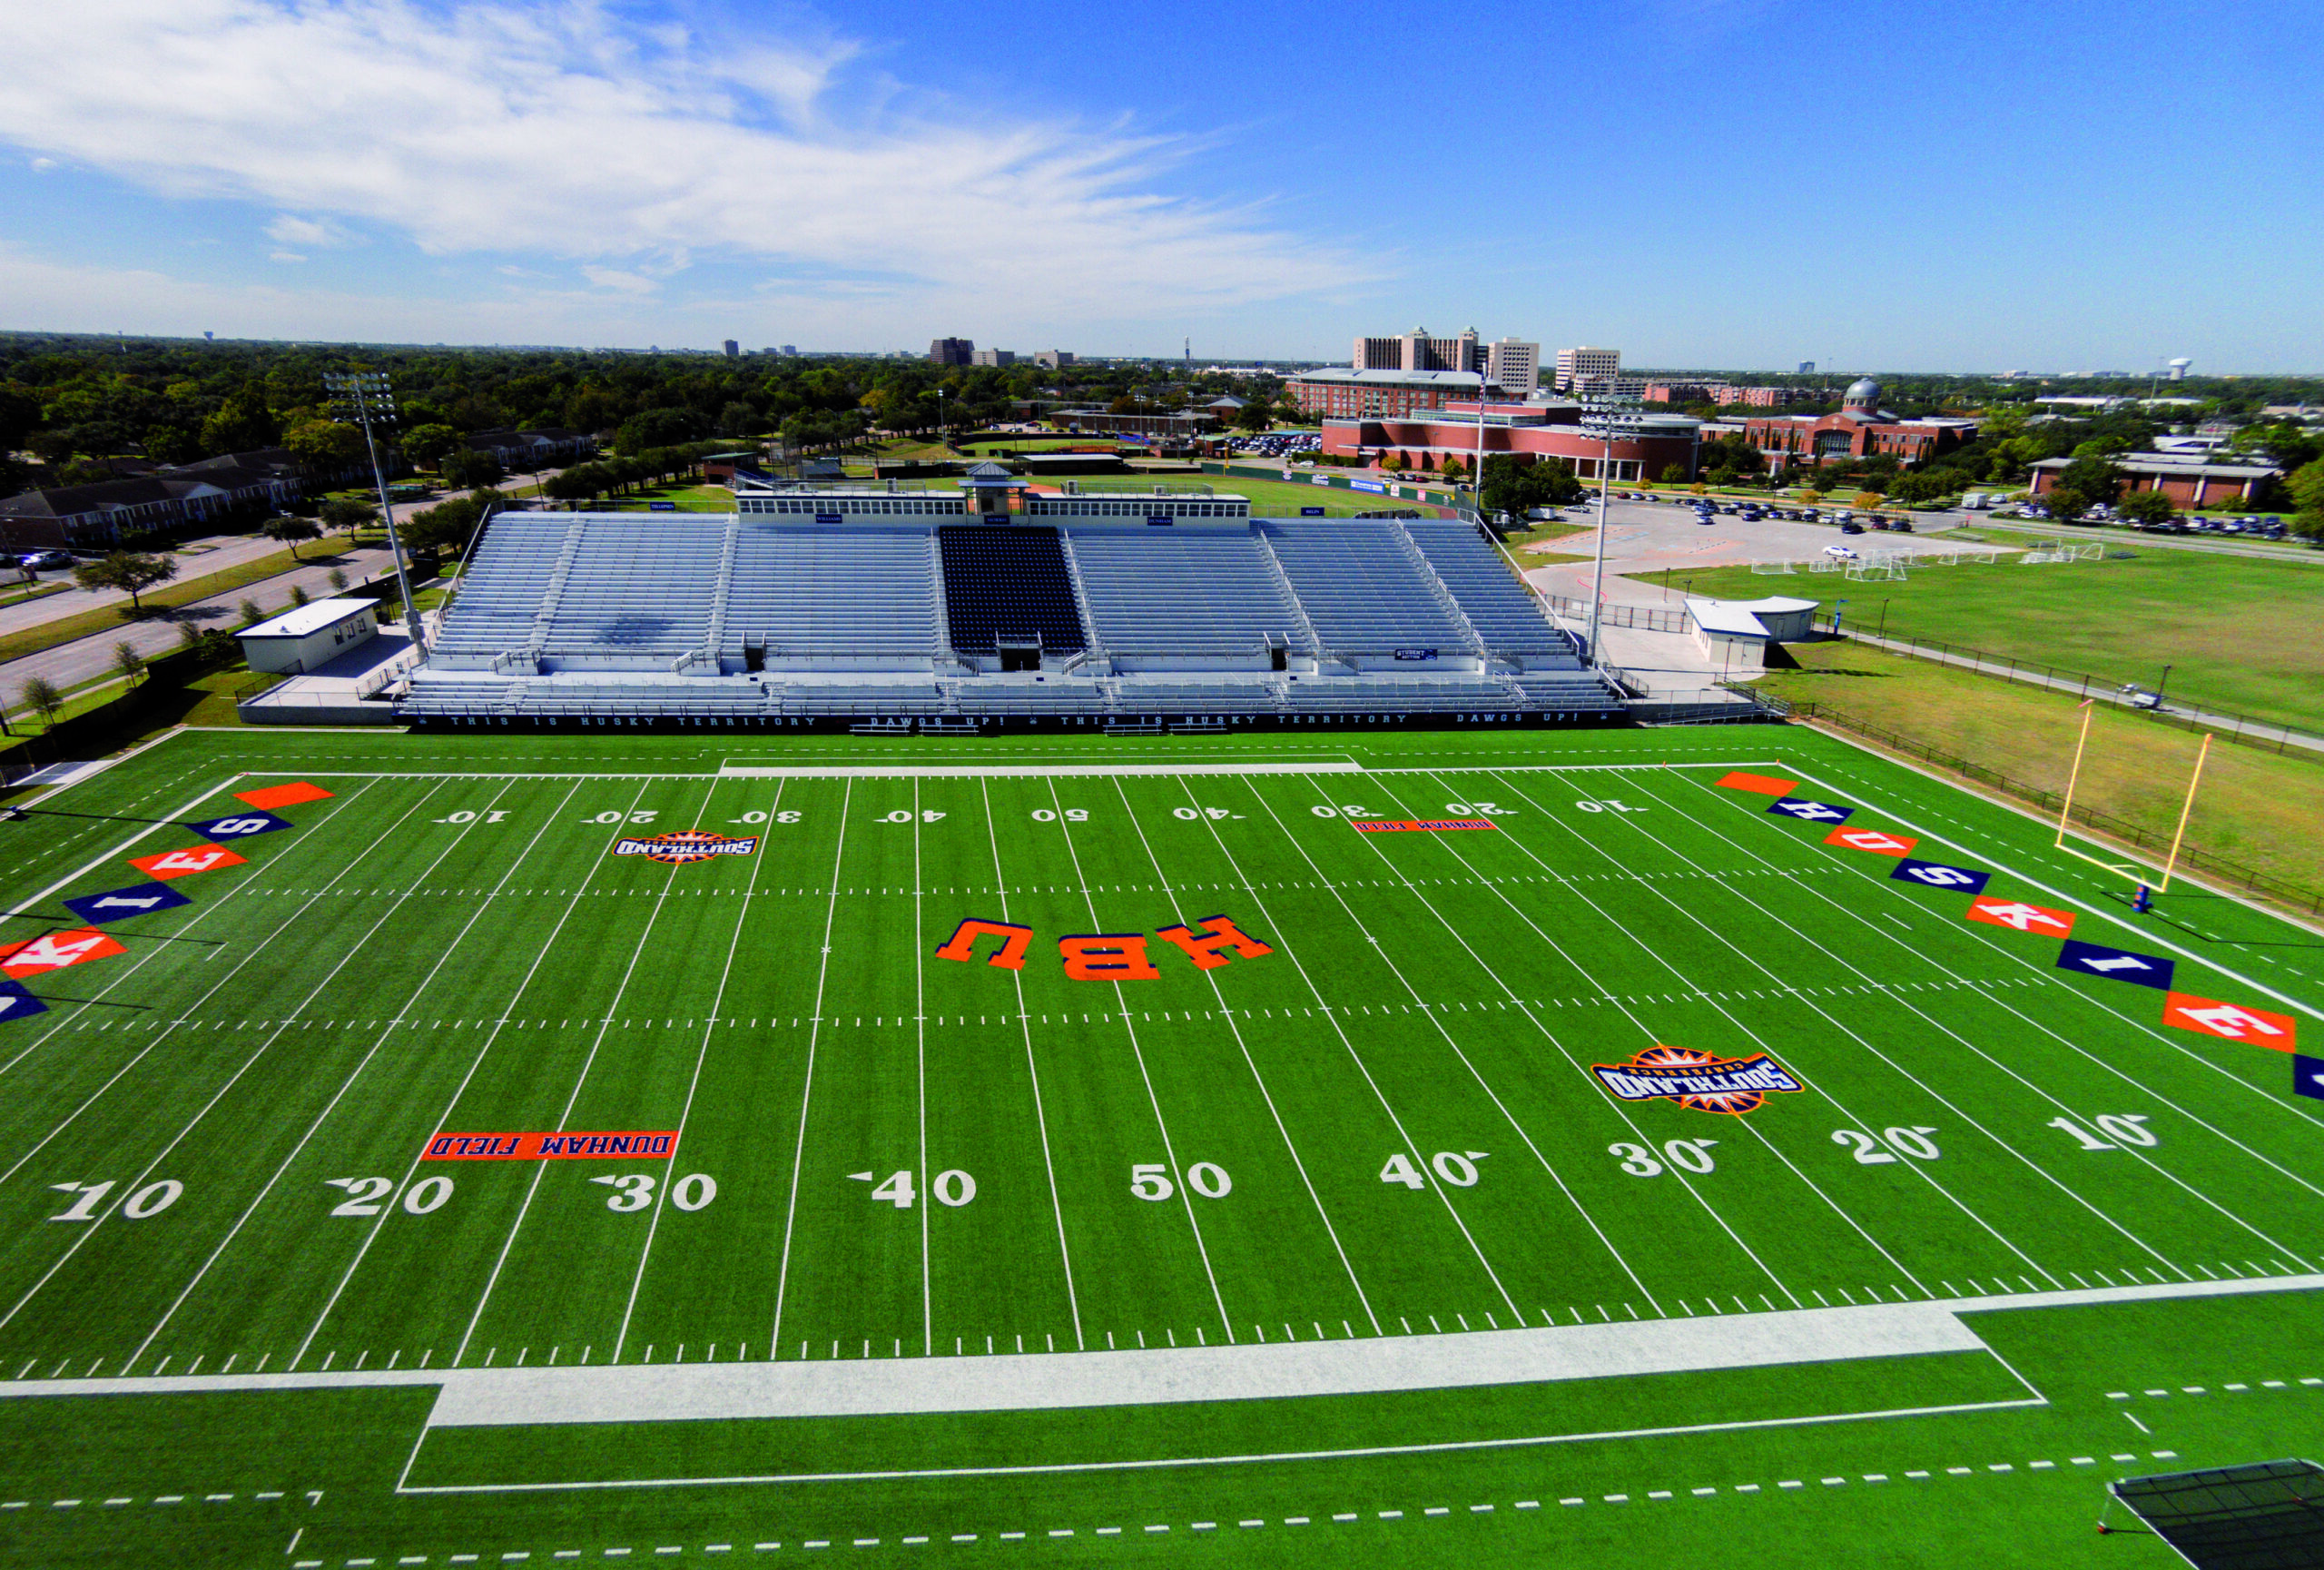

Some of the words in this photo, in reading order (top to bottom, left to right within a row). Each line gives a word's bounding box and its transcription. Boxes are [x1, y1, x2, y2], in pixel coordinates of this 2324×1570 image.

[451, 716, 508, 726] THIS
[535, 717, 556, 726] IS
[581, 717, 654, 726] HUSKY
[677, 717, 815, 726] TERRITORY
[871, 717, 942, 726] DAWGS
[966, 716, 1004, 726] UP!
[1061, 716, 1115, 725] THIS
[1140, 716, 1162, 725] IS
[1186, 716, 1256, 725] HUSKY
[1278, 715, 1406, 724] TERRITORY
[1457, 714, 1522, 722] DAWGS
[1543, 713, 1578, 721] UP!
[1173, 807, 1229, 820] 40
[1312, 805, 1370, 818] 30
[1445, 803, 1504, 815] 20
[1576, 800, 1633, 813] 10
[448, 811, 510, 824] 10
[596, 810, 658, 824] 20
[743, 810, 802, 824] 30
[888, 810, 946, 823] 40
[1032, 809, 1088, 822] 50
[1356, 822, 1407, 831] FIELD
[1416, 821, 1492, 830] DUNHAM
[615, 840, 755, 854] SOUTHLAND
[935, 913, 1275, 981] HBU
[1628, 1063, 1745, 1076] CONFERENCE
[1599, 1060, 1797, 1098] SOUTHLAND
[2047, 1114, 2157, 1150] 10
[431, 1137, 519, 1157] FIELD
[537, 1135, 671, 1155] DUNHAM
[1831, 1127, 1939, 1163] 20
[1609, 1140, 1714, 1176] 30
[1380, 1152, 1479, 1189] 40
[1131, 1162, 1232, 1200] 50
[330, 1177, 454, 1215] 20
[607, 1174, 716, 1211] 30
[872, 1170, 976, 1208] 40
[49, 1180, 183, 1219] 10
